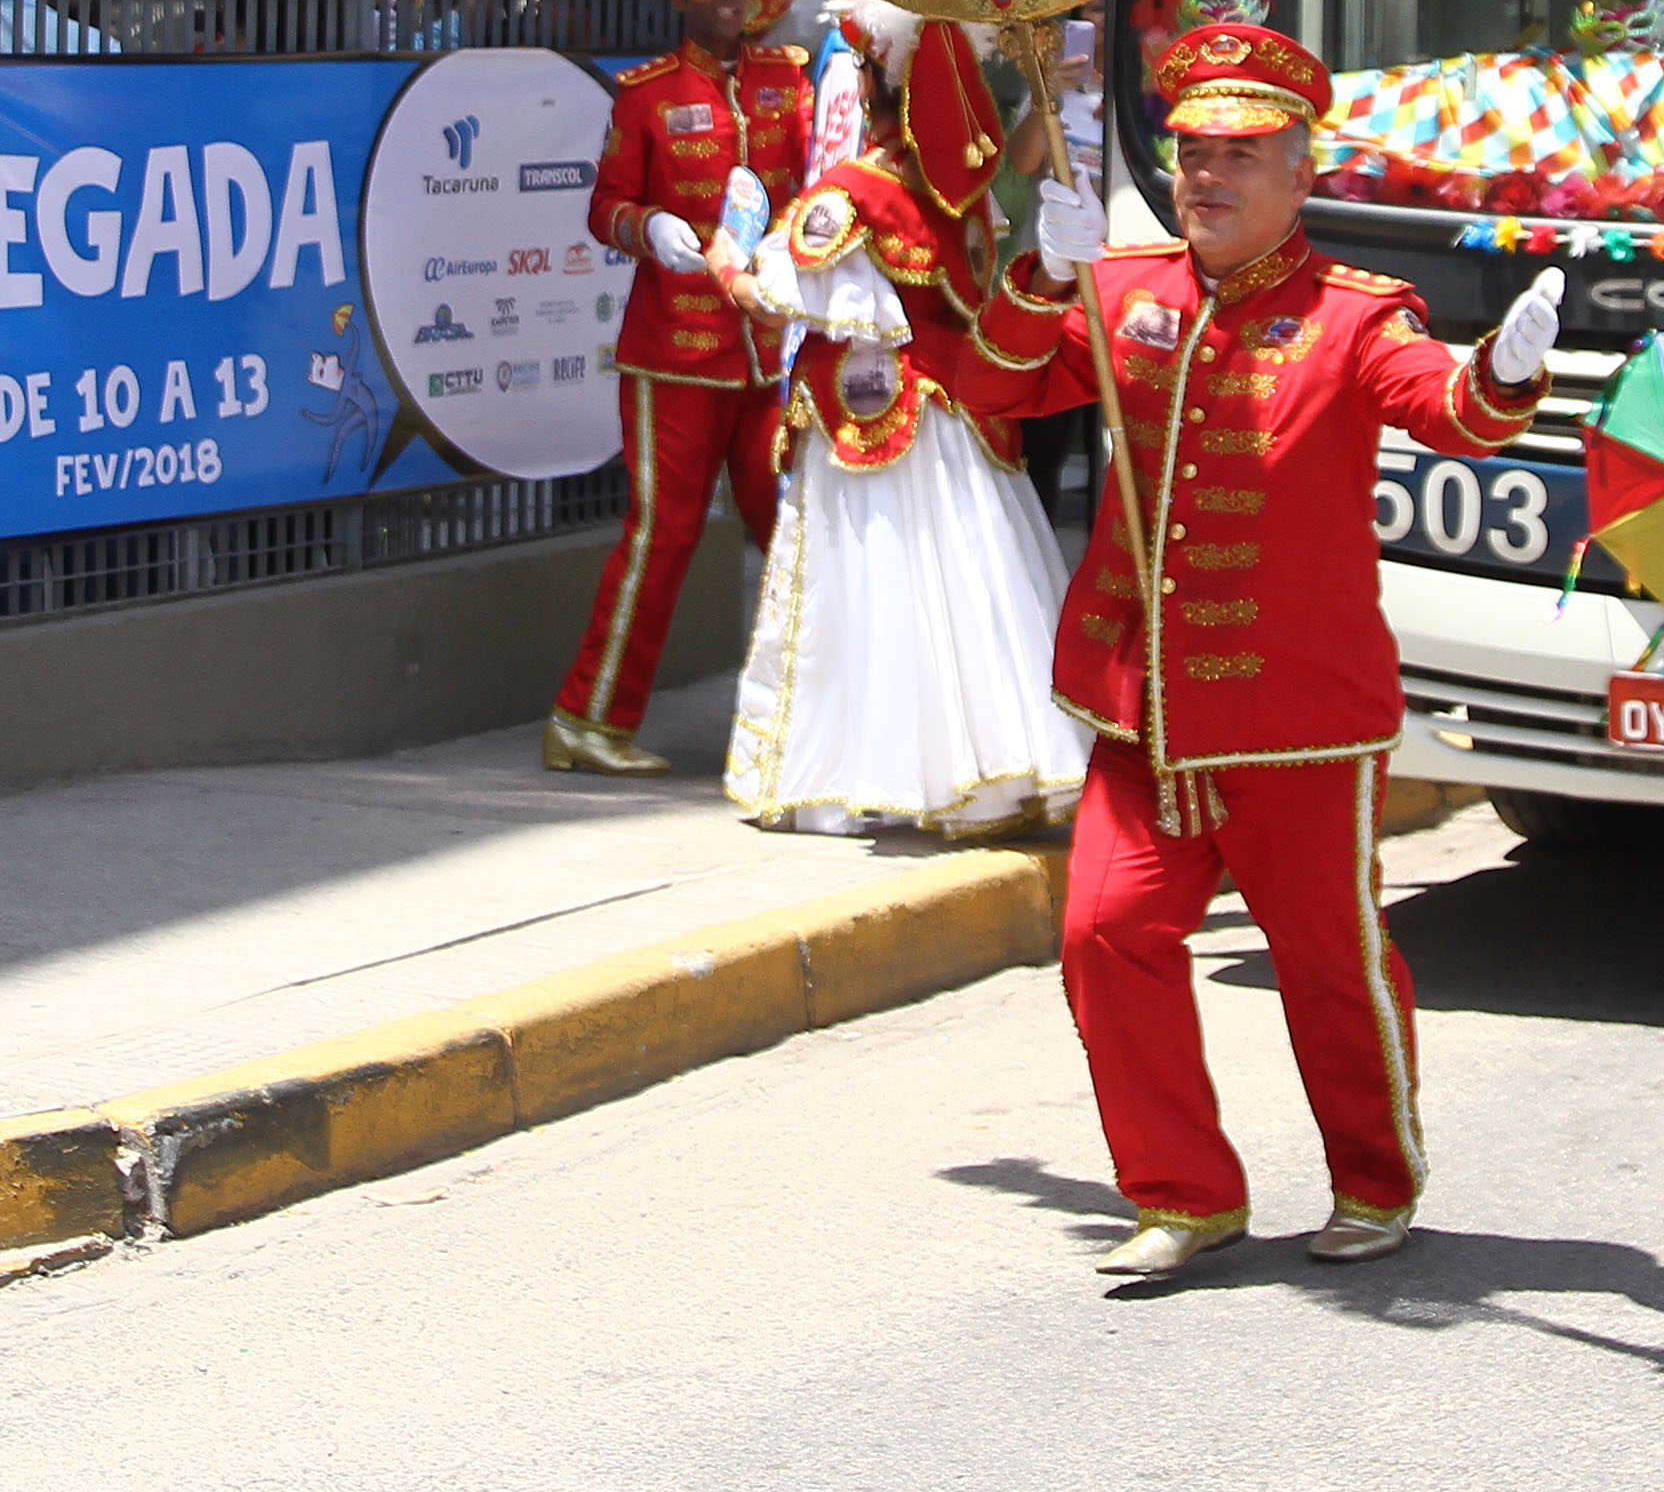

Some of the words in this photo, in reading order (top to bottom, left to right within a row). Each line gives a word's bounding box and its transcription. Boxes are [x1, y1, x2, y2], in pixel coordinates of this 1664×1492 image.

[423, 175, 499, 195] Tacaruna
[524, 168, 582, 186] TRANSCOL
[508, 248, 552, 275] SKOL
[445, 368, 483, 387] CTTU
[75, 365, 139, 430] 10
[160, 359, 197, 422] A
[214, 352, 271, 418] 13
[56, 438, 223, 497] FEV/2018
